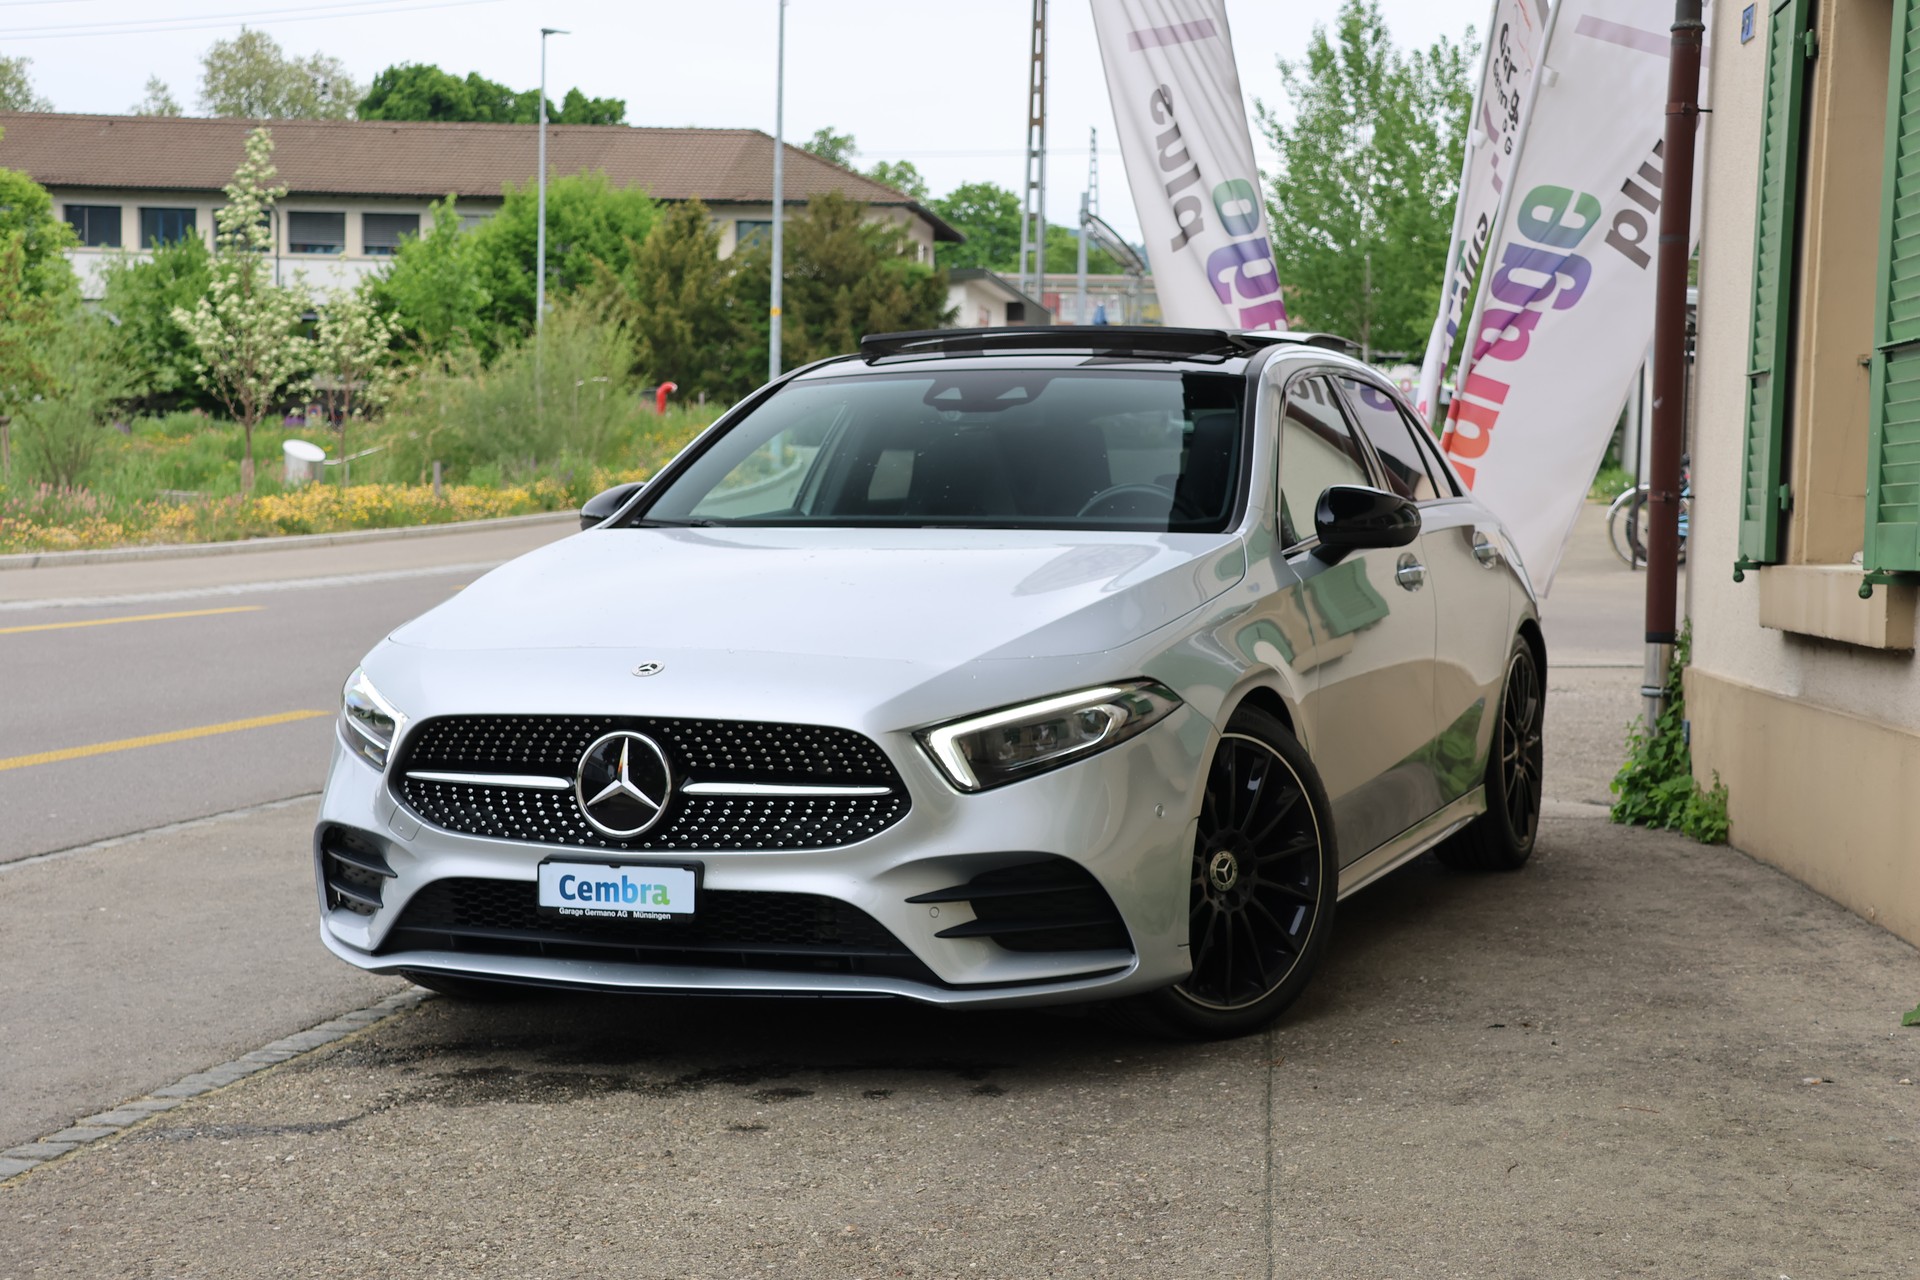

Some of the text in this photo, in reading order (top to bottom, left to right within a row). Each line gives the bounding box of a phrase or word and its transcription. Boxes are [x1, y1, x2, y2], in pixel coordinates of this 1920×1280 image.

[1441, 184, 1602, 492] arage
[559, 875, 670, 905] Cembra
[559, 908, 583, 916] Garage
[585, 909, 615, 917] Germano
[633, 911, 671, 920] Münsingen
